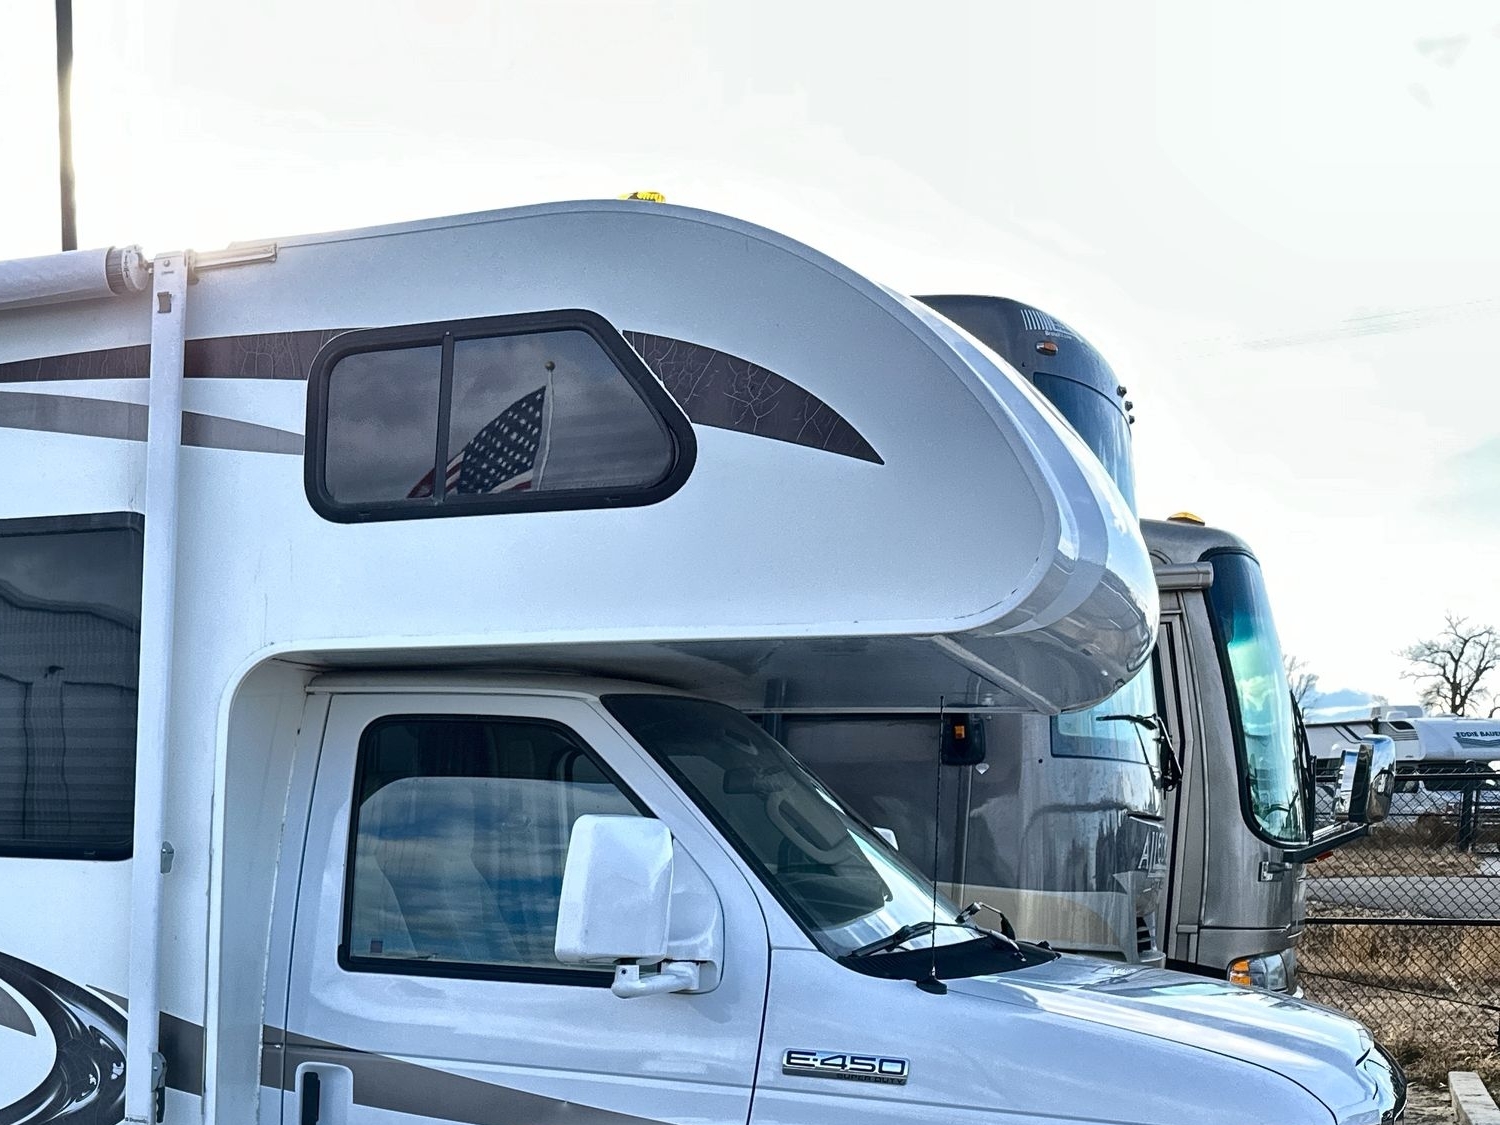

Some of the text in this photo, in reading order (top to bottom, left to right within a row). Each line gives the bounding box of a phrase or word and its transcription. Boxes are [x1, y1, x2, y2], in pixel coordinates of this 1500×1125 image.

[786, 1050, 906, 1076] E-450
[837, 1073, 904, 1084] SUPER DUTY
